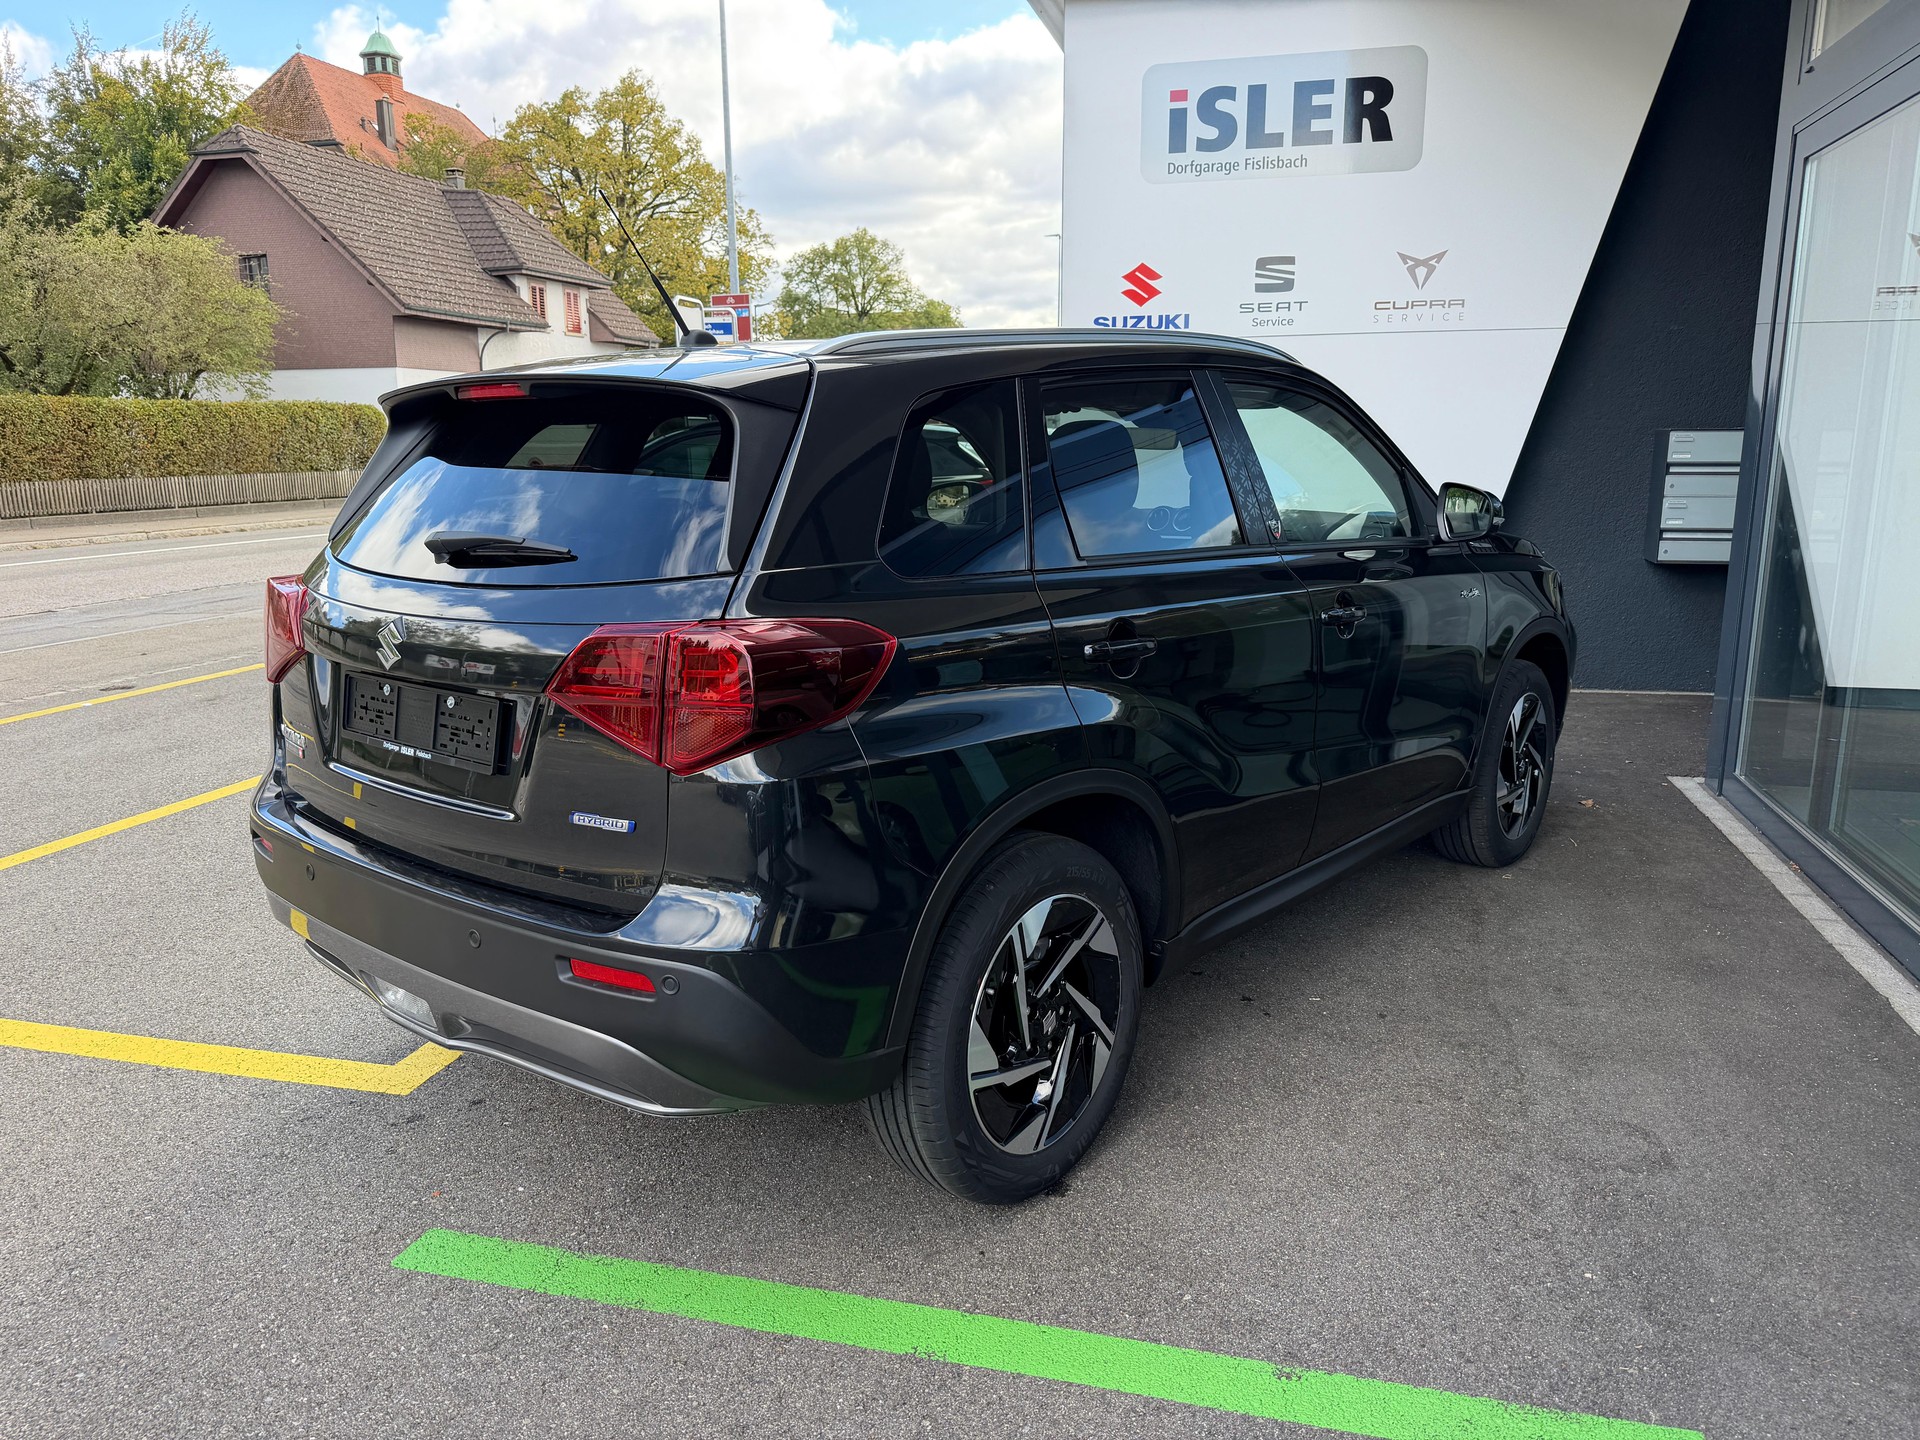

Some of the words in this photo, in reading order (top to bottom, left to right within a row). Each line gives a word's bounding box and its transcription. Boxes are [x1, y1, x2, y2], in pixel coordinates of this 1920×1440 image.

[1167, 159, 1240, 177] Dorfgarage
[1244, 154, 1308, 171] Fislisbach
[1239, 301, 1308, 313] SEAT
[1374, 299, 1465, 310] CUPRA
[1093, 313, 1190, 329] SUZUKI
[1251, 316, 1294, 327] Service
[1373, 312, 1465, 323] SERVICE
[577, 815, 624, 829] HYBRID
